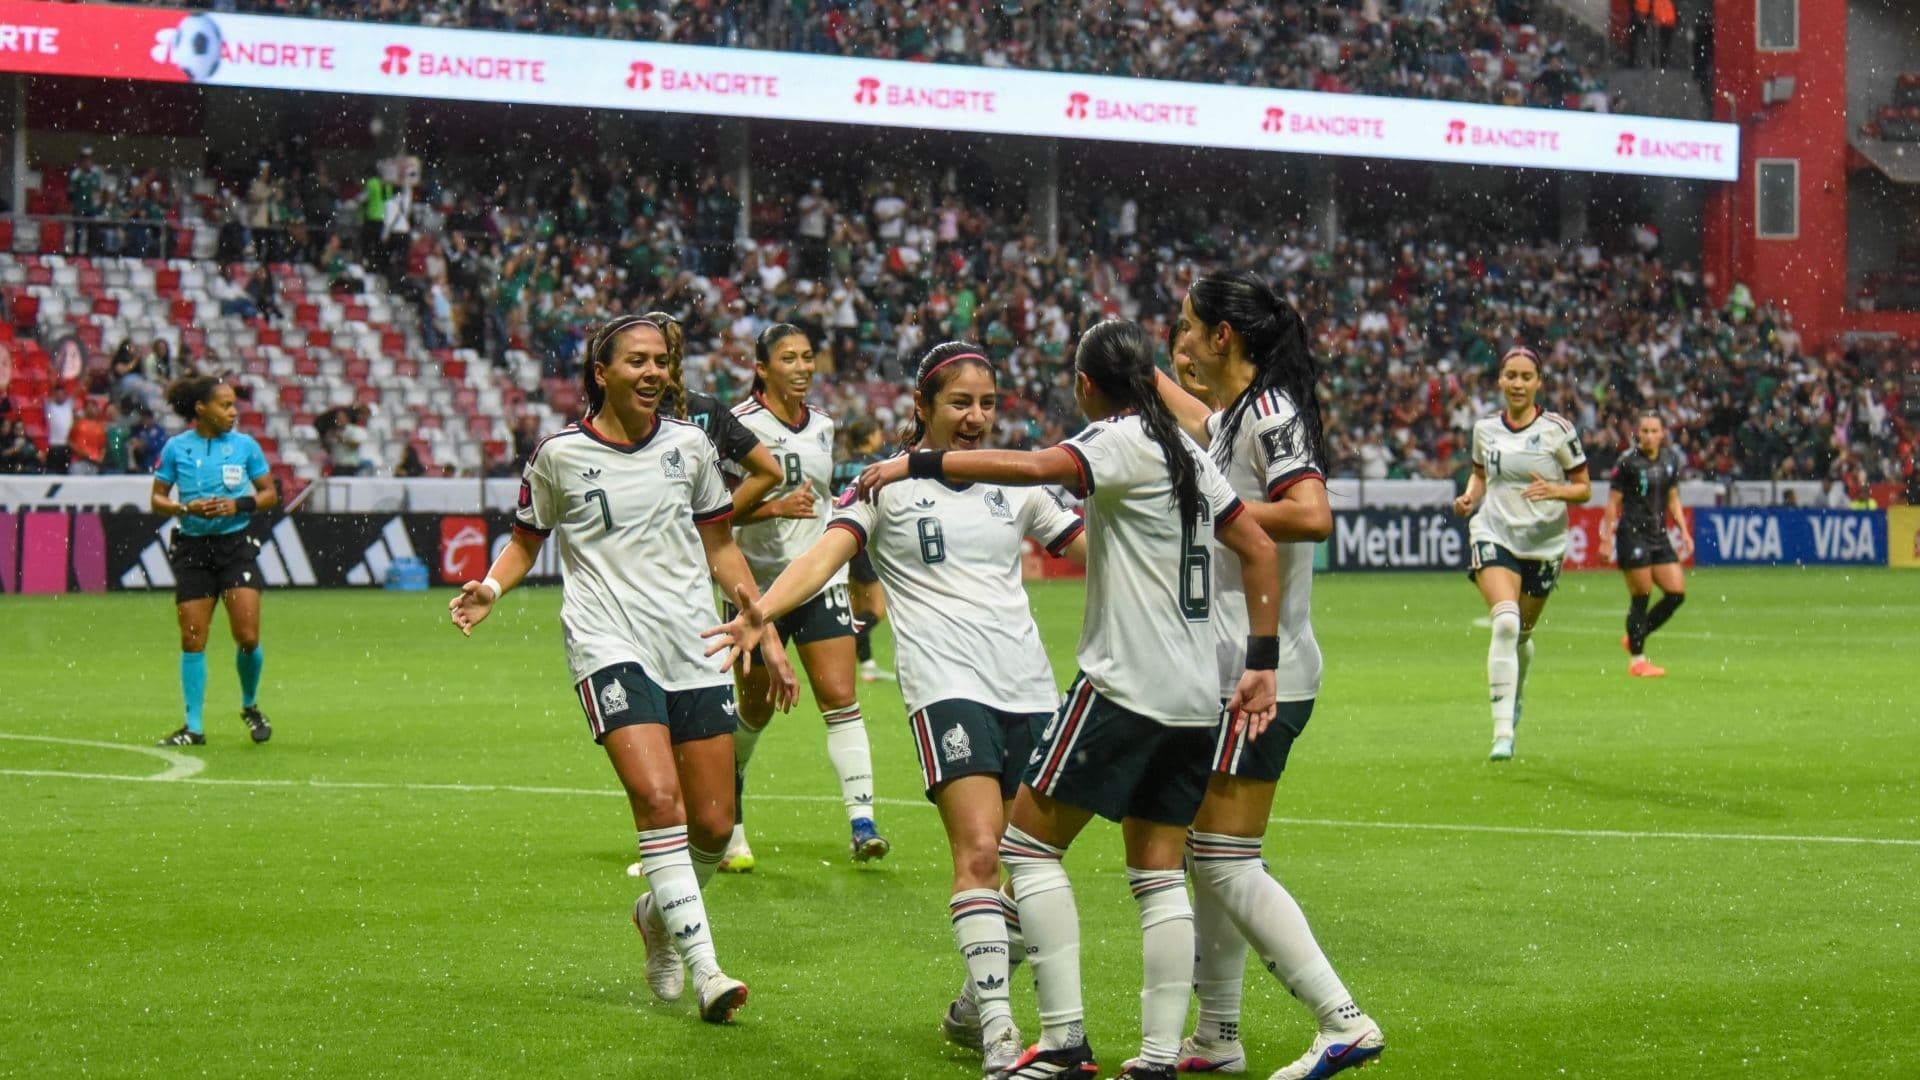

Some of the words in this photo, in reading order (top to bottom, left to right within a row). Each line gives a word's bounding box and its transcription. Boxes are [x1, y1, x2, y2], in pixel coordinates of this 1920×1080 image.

[0, 25, 59, 53] RTE
[220, 40, 334, 71] ANORTE
[418, 52, 545, 83] BANORTE
[660, 68, 778, 98] BANORTE
[887, 85, 995, 112] BANORTE
[1095, 99, 1197, 126] BANORTE
[1289, 114, 1384, 138] BANORTE
[1471, 127, 1559, 150] BANORTE
[1640, 139, 1722, 161] BANORTE
[584, 488, 612, 532] 7
[917, 517, 945, 563] 8
[1335, 514, 1461, 566] MetLife
[1710, 514, 1783, 560] VISA
[1808, 515, 1875, 560] VISA
[1179, 495, 1211, 623] 6
[966, 946, 1006, 959] MÉXICO
